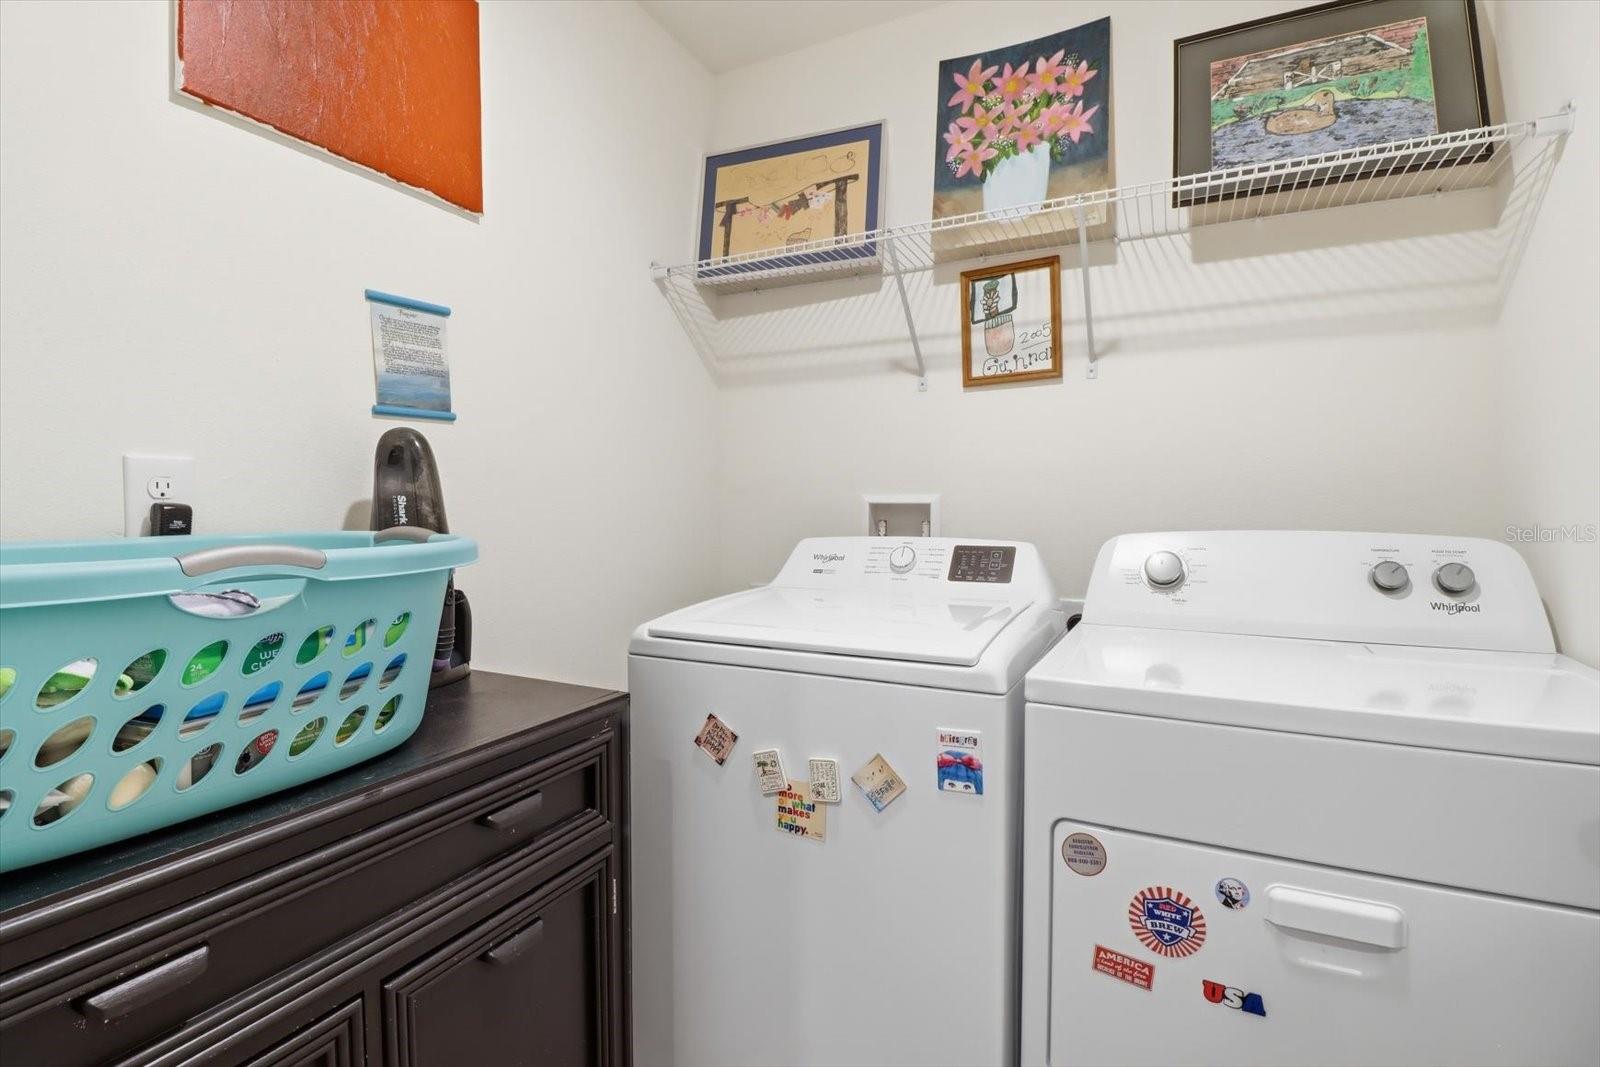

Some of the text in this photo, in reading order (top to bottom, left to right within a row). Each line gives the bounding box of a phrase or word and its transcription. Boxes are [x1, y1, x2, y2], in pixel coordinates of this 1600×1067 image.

[1019, 322, 1052, 344] 2005
[397, 495, 408, 525] Shark
[813, 552, 846, 564] Whirlpool
[1430, 601, 1481, 616] Whirlpool
[778, 790, 804, 802] more
[778, 805, 811, 819] makes
[791, 800, 816, 813] what
[777, 818, 809, 835] happy.
[1152, 909, 1182, 920] WHITE
[1150, 921, 1185, 934] BREW
[1098, 950, 1150, 976] AMERICA
[1202, 979, 1267, 1017] USA
